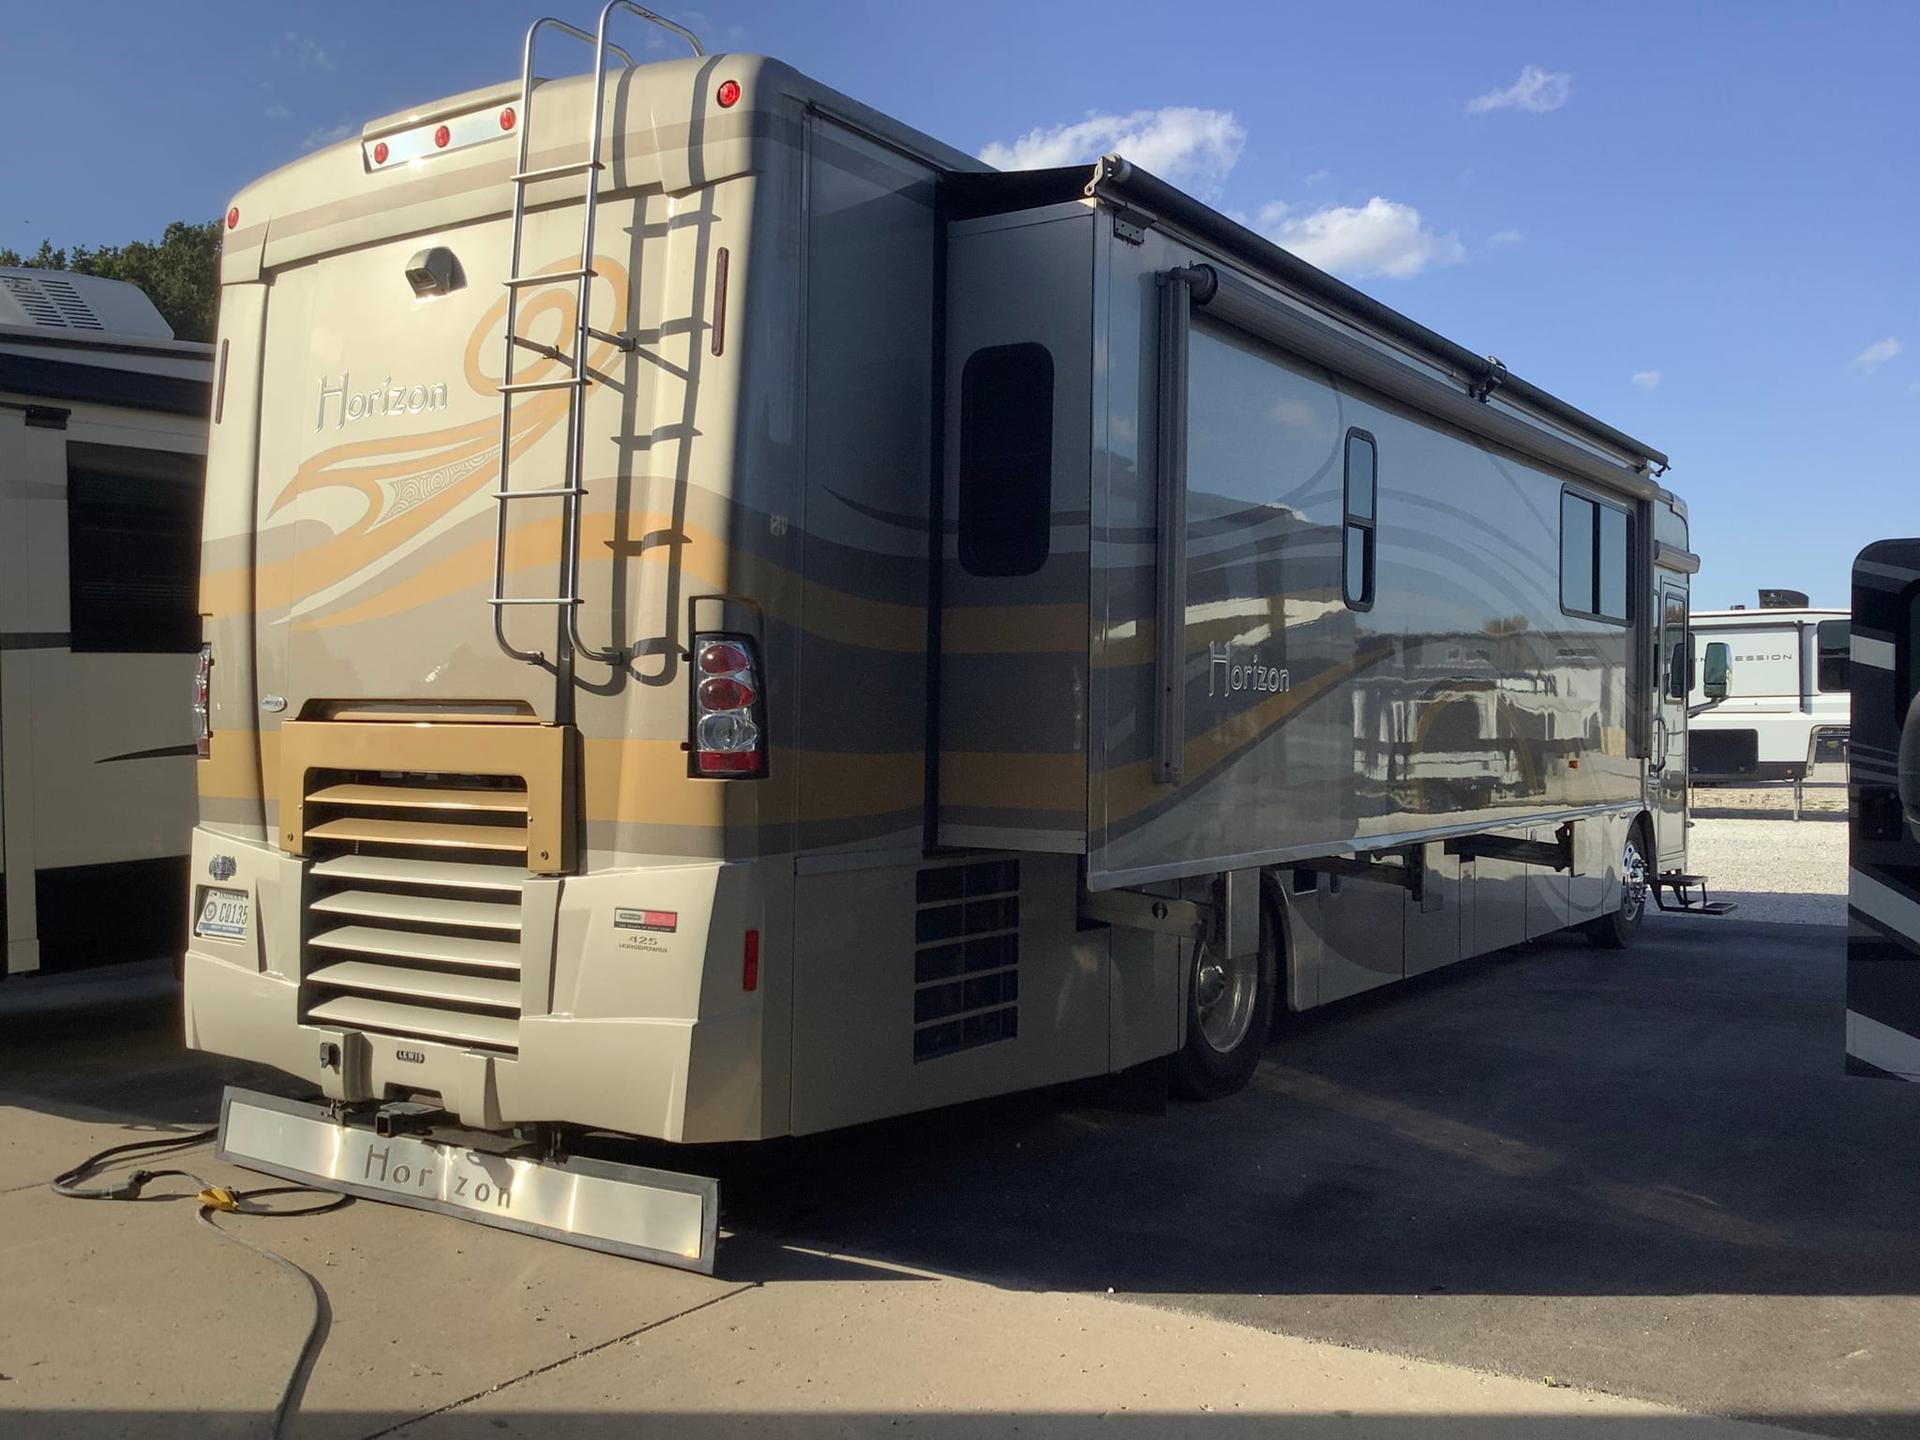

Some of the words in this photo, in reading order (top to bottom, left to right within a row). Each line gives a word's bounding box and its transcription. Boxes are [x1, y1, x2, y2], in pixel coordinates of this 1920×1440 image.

[315, 368, 448, 433] Horizon
[1208, 640, 1290, 697] Horizon
[629, 936, 658, 945] 425
[364, 1143, 512, 1209] Horzon
